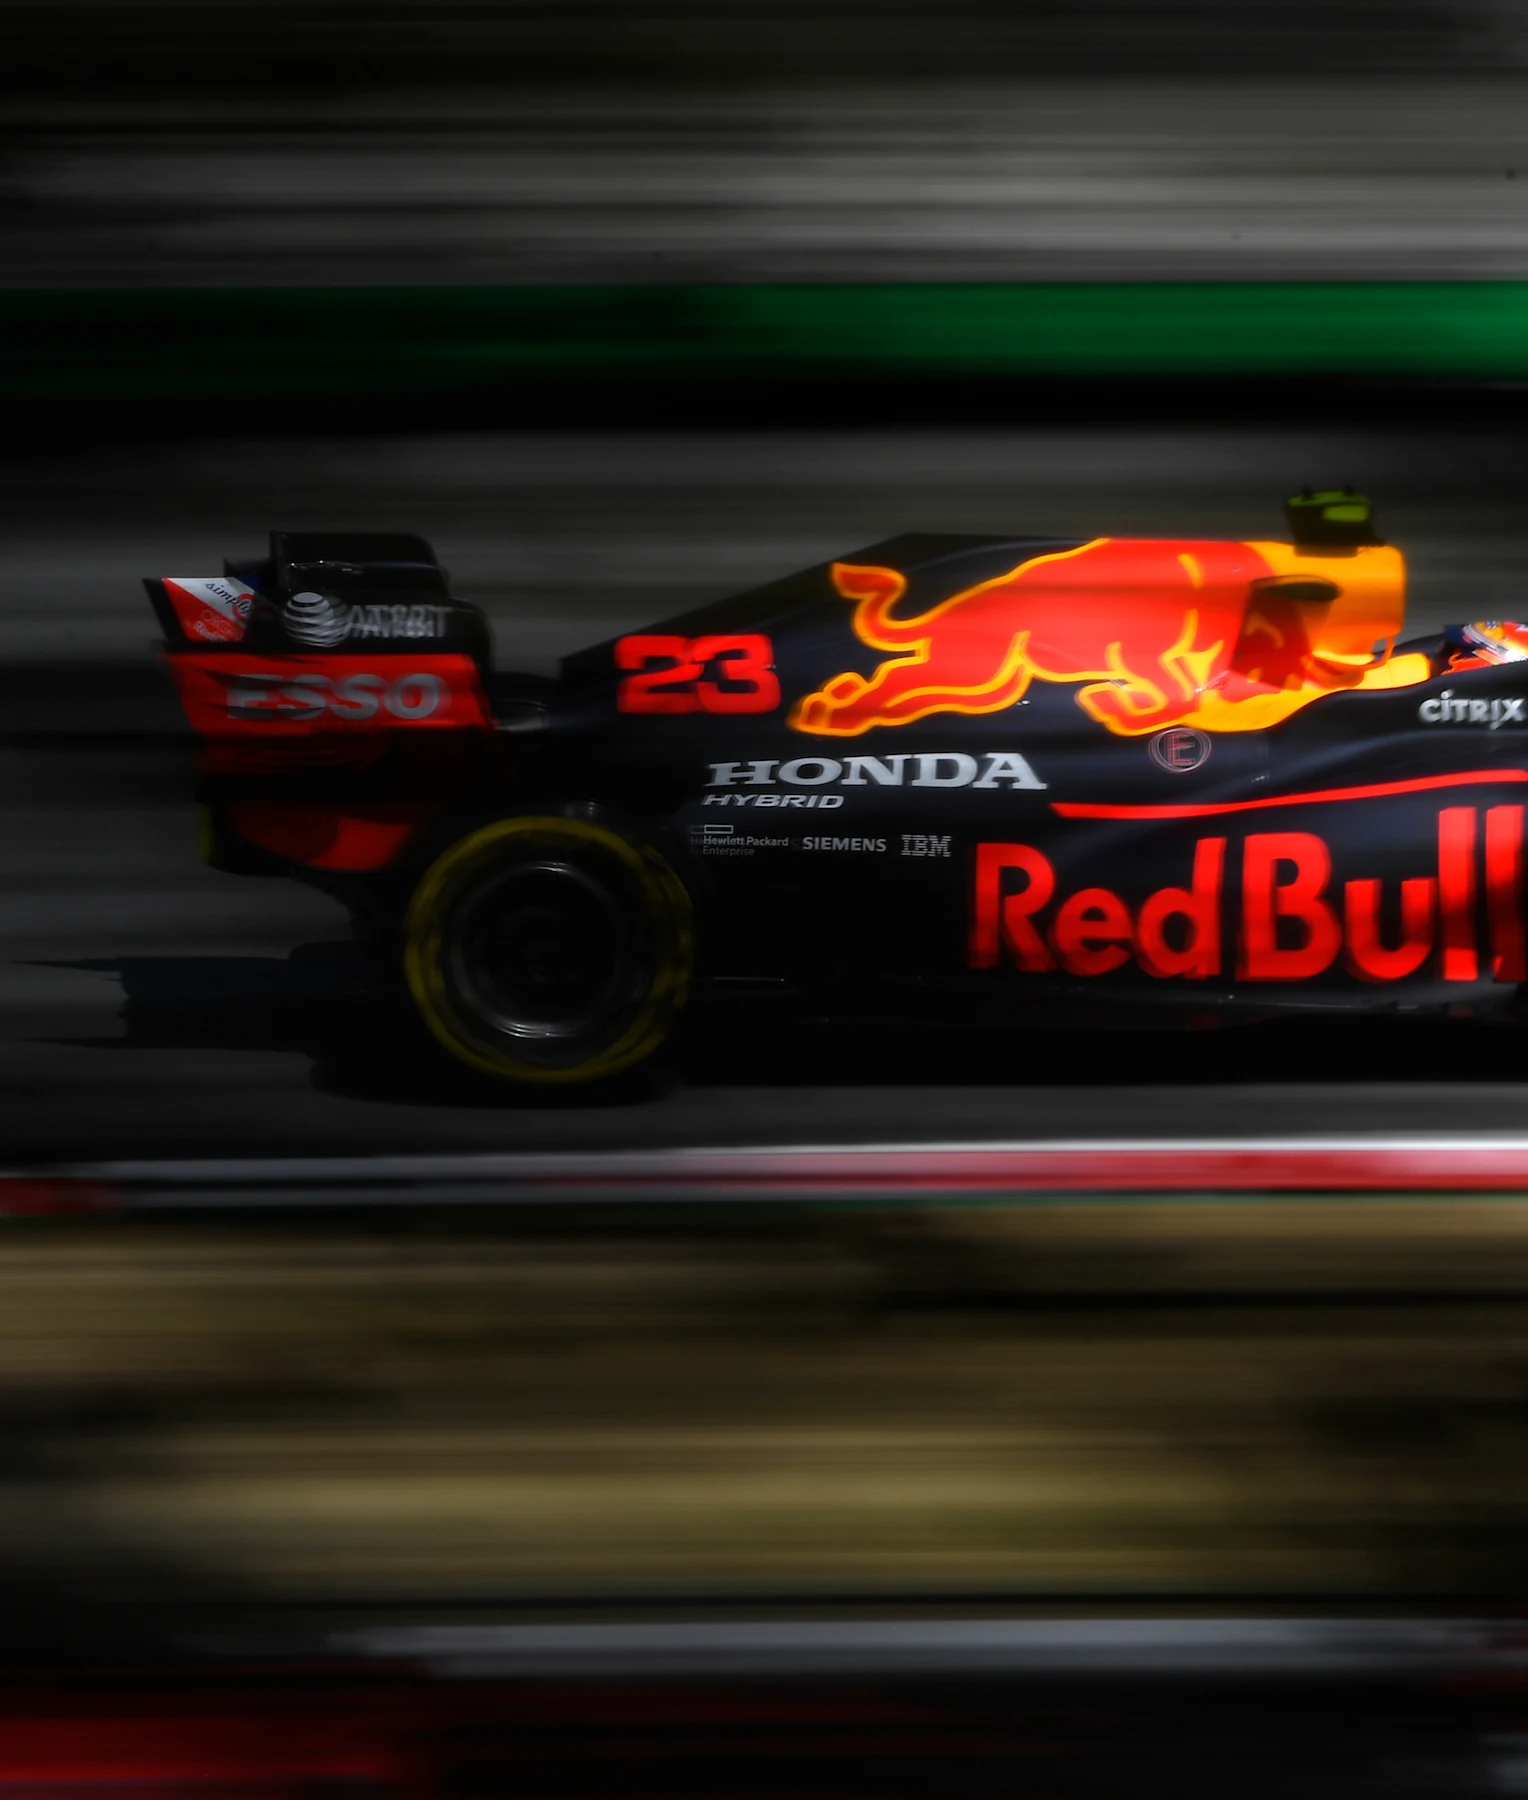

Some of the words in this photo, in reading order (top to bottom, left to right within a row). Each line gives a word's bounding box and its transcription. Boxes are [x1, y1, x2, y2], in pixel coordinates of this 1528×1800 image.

[613, 634, 781, 713] 23
[226, 672, 451, 720] ESSO
[704, 753, 1048, 790] HONDA
[701, 793, 844, 809] HYBRID
[702, 834, 745, 847] Hewlett
[747, 835, 789, 848] Packard
[802, 836, 887, 853] SIEMENS
[901, 833, 951, 857] IBM
[702, 846, 756, 859] Enterprise
